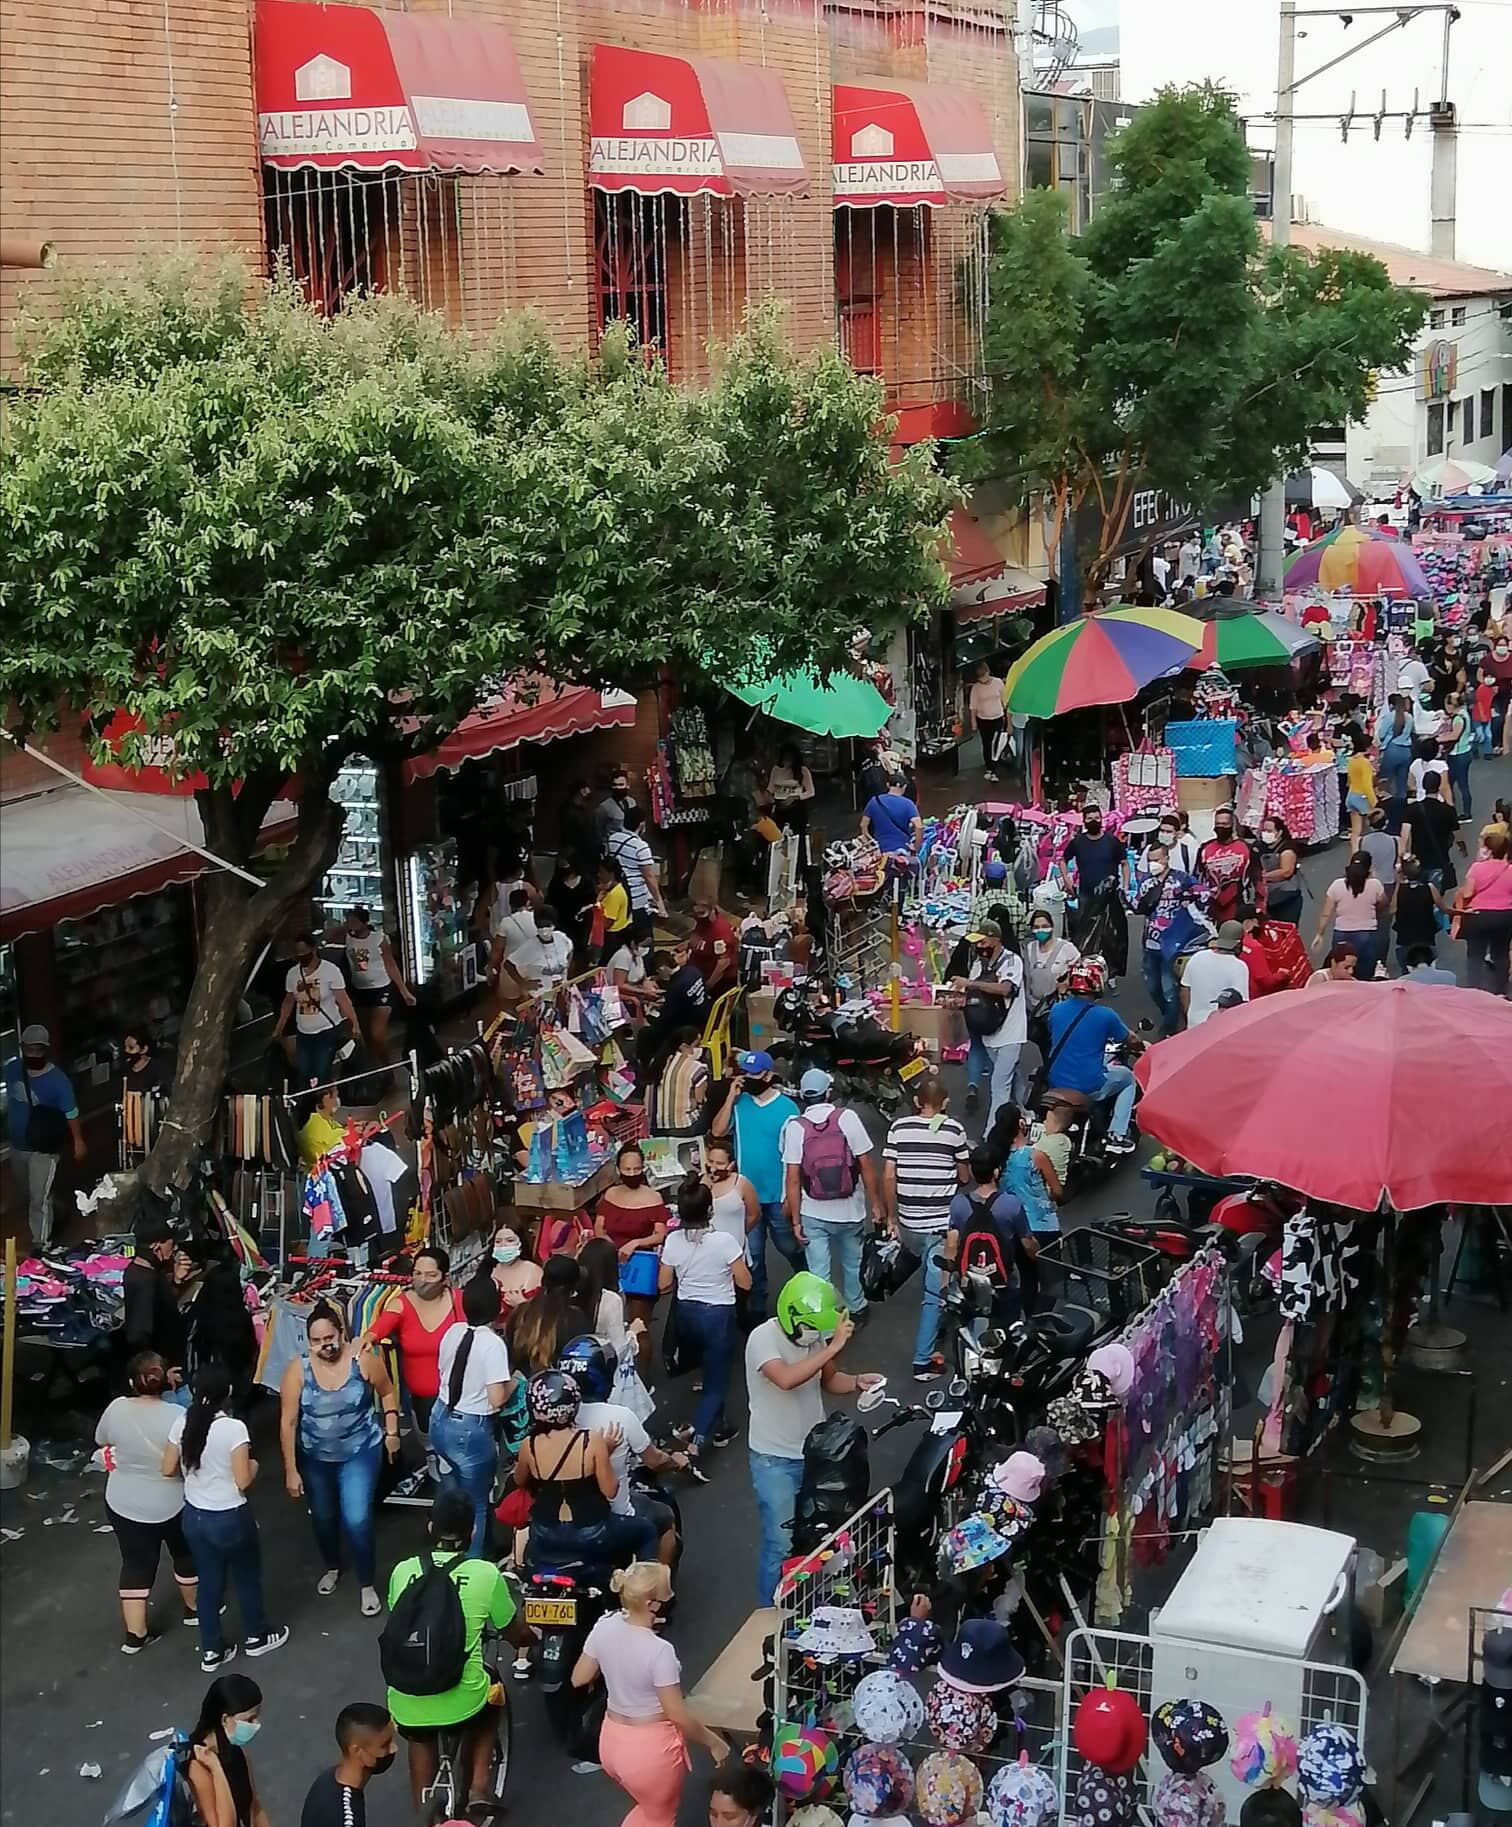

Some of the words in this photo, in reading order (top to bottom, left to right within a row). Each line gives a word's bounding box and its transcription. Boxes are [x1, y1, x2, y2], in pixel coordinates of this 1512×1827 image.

[262, 111, 413, 140] ALEJANDRIA
[592, 140, 721, 162] ALEJANDRIA
[645, 163, 717, 173] Comercia
[527, 1603, 548, 1618] DCV
[552, 1604, 574, 1619] 76C
